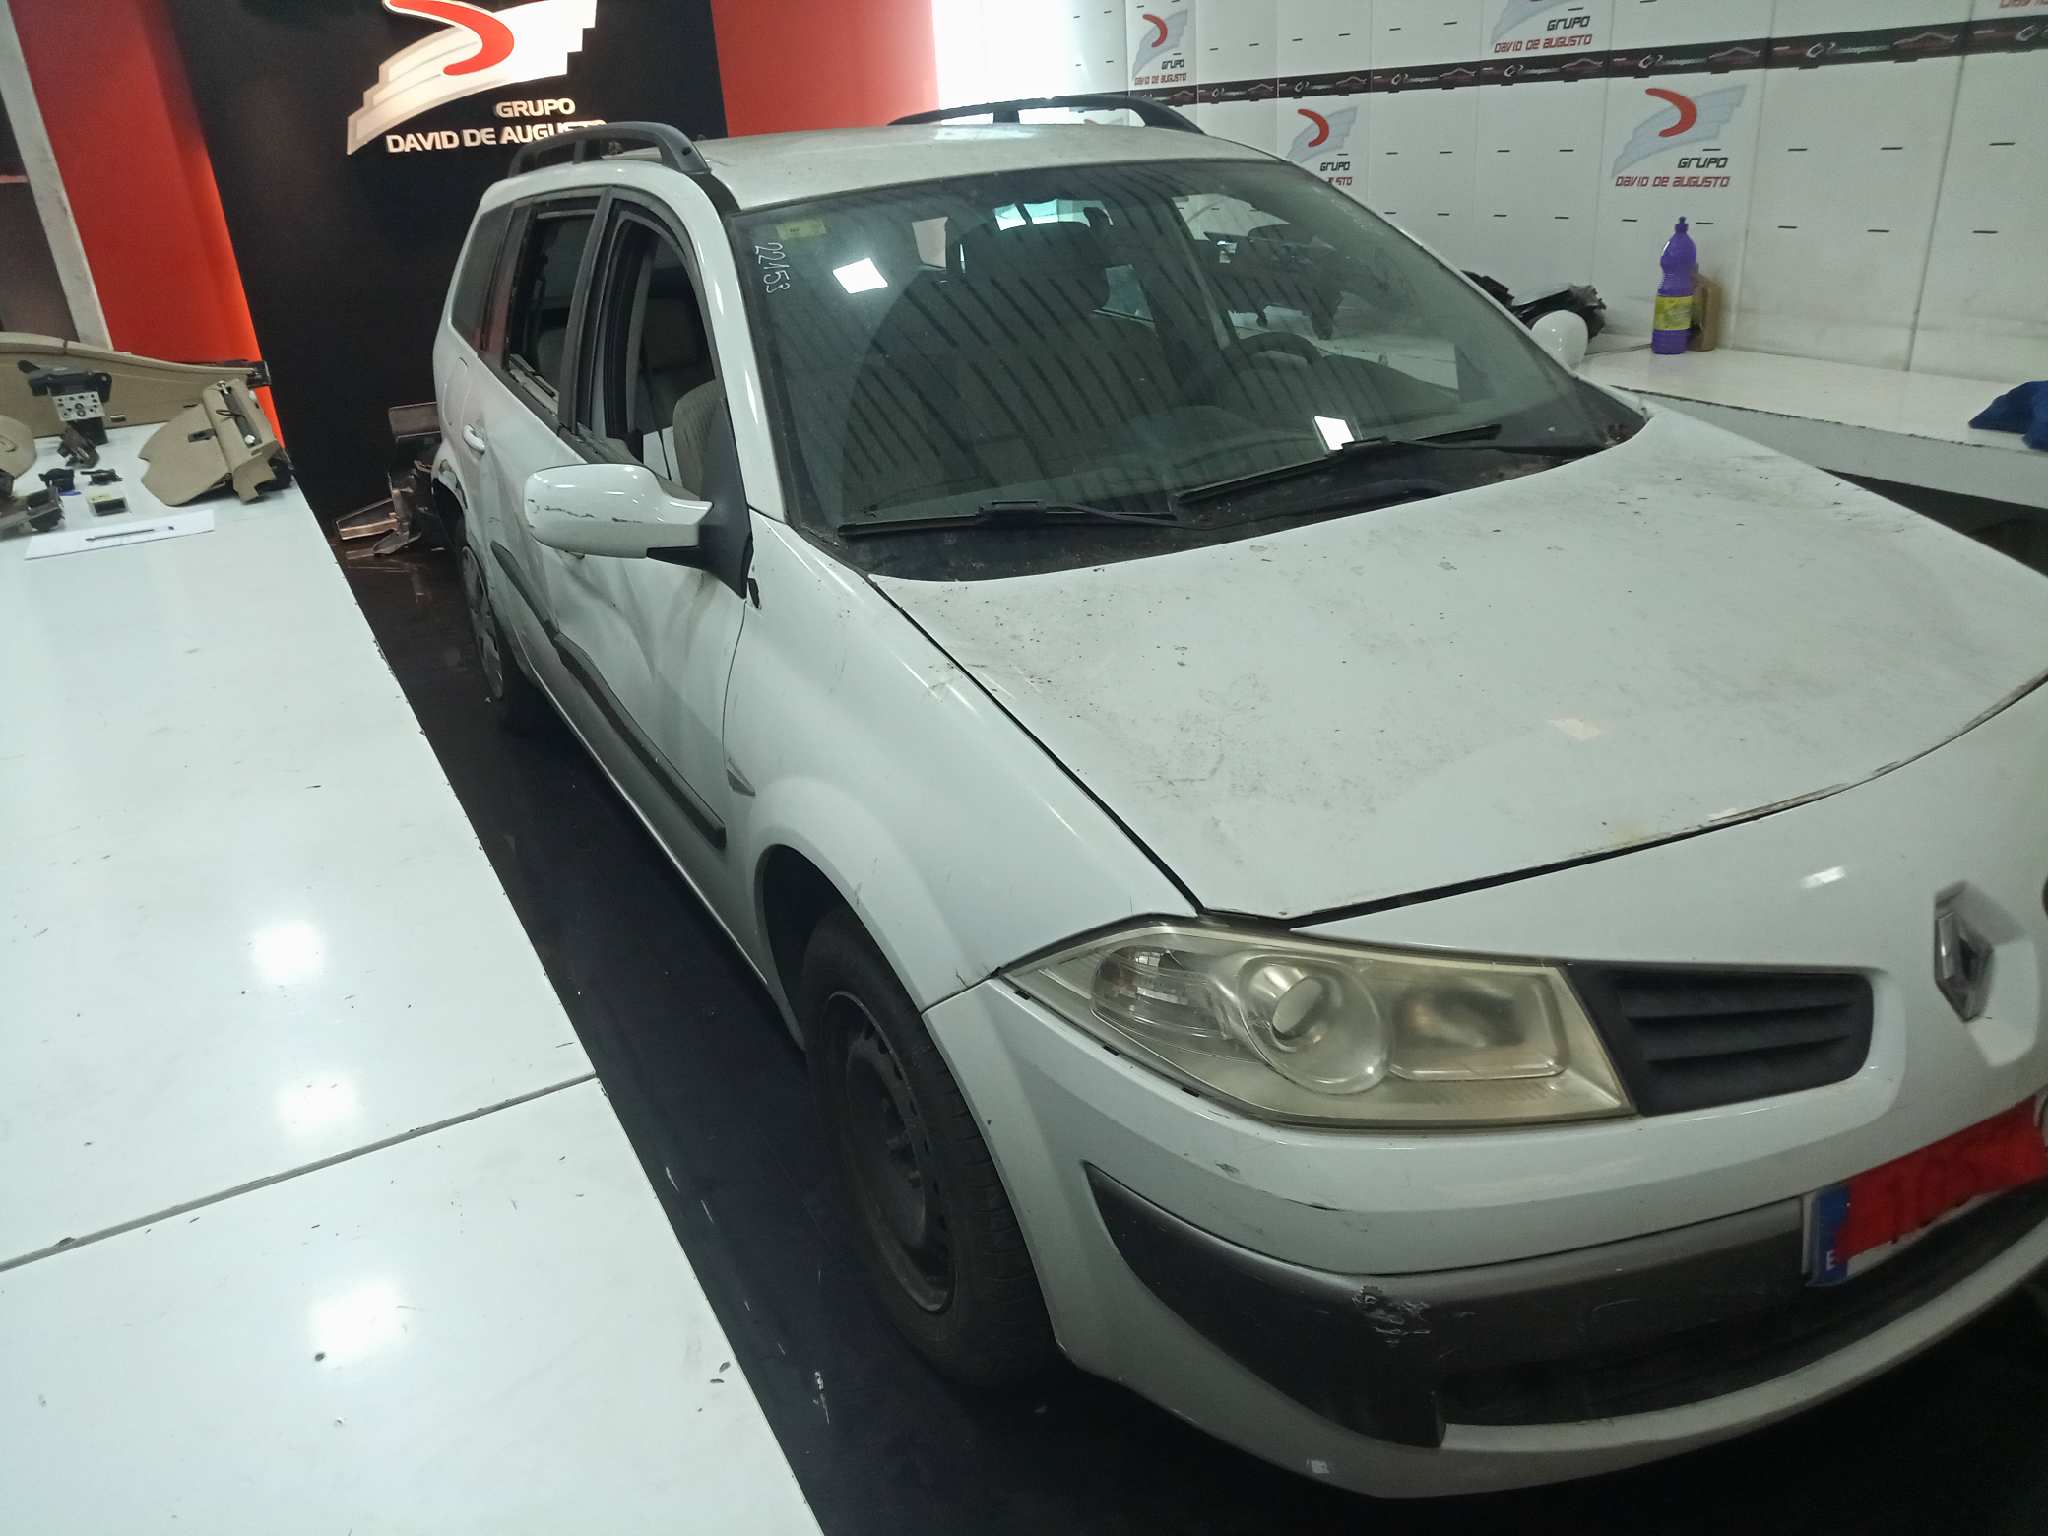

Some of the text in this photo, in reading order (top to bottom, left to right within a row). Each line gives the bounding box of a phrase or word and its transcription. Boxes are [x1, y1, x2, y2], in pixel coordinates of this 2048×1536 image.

[1547, 16, 1590, 31] GRUPO
[494, 98, 576, 118] GRUPO
[386, 130, 460, 153] DAVID
[462, 128, 497, 147] DE
[1678, 157, 1728, 168] GRUPO
